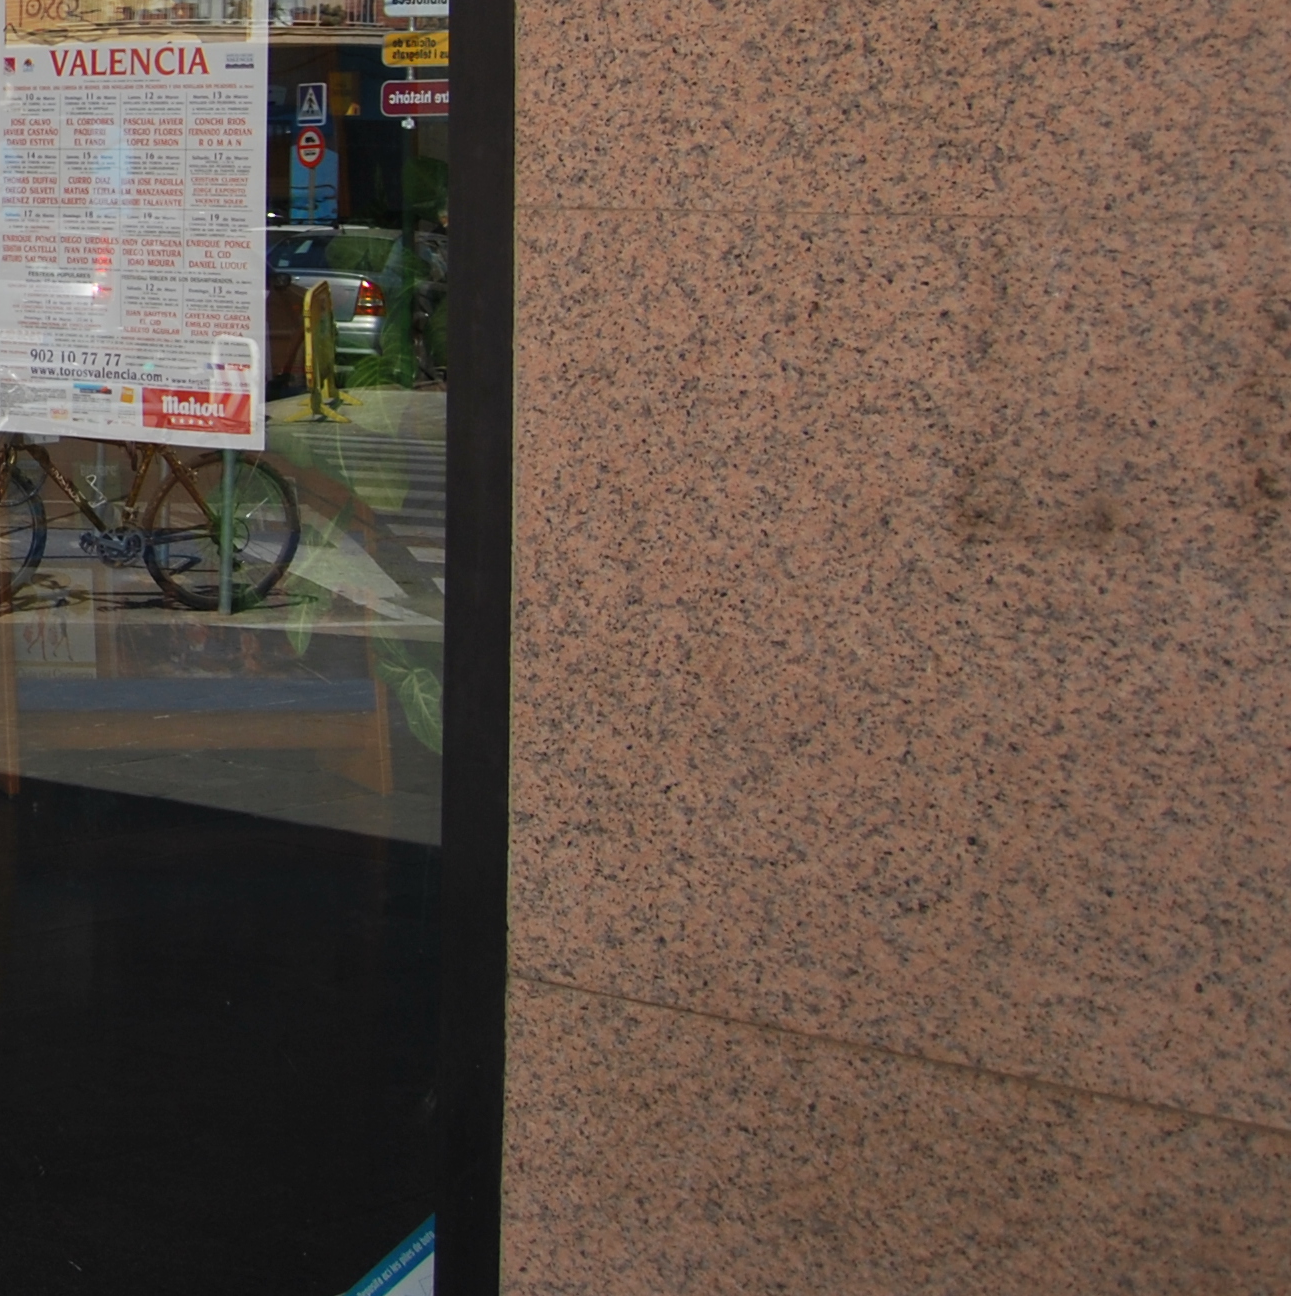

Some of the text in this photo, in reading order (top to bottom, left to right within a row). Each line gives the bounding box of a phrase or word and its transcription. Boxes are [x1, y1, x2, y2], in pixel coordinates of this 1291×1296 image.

[49, 47, 210, 77] VALENCIA
[223, 128, 252, 136] ADRIAN
[225, 239, 252, 249] PONCE
[147, 249, 181, 257] VENTURA
[30, 349, 121, 366] 902 10 77 77
[31, 366, 163, 383] www.torosvalencia.com
[162, 394, 225, 418] Mahou
